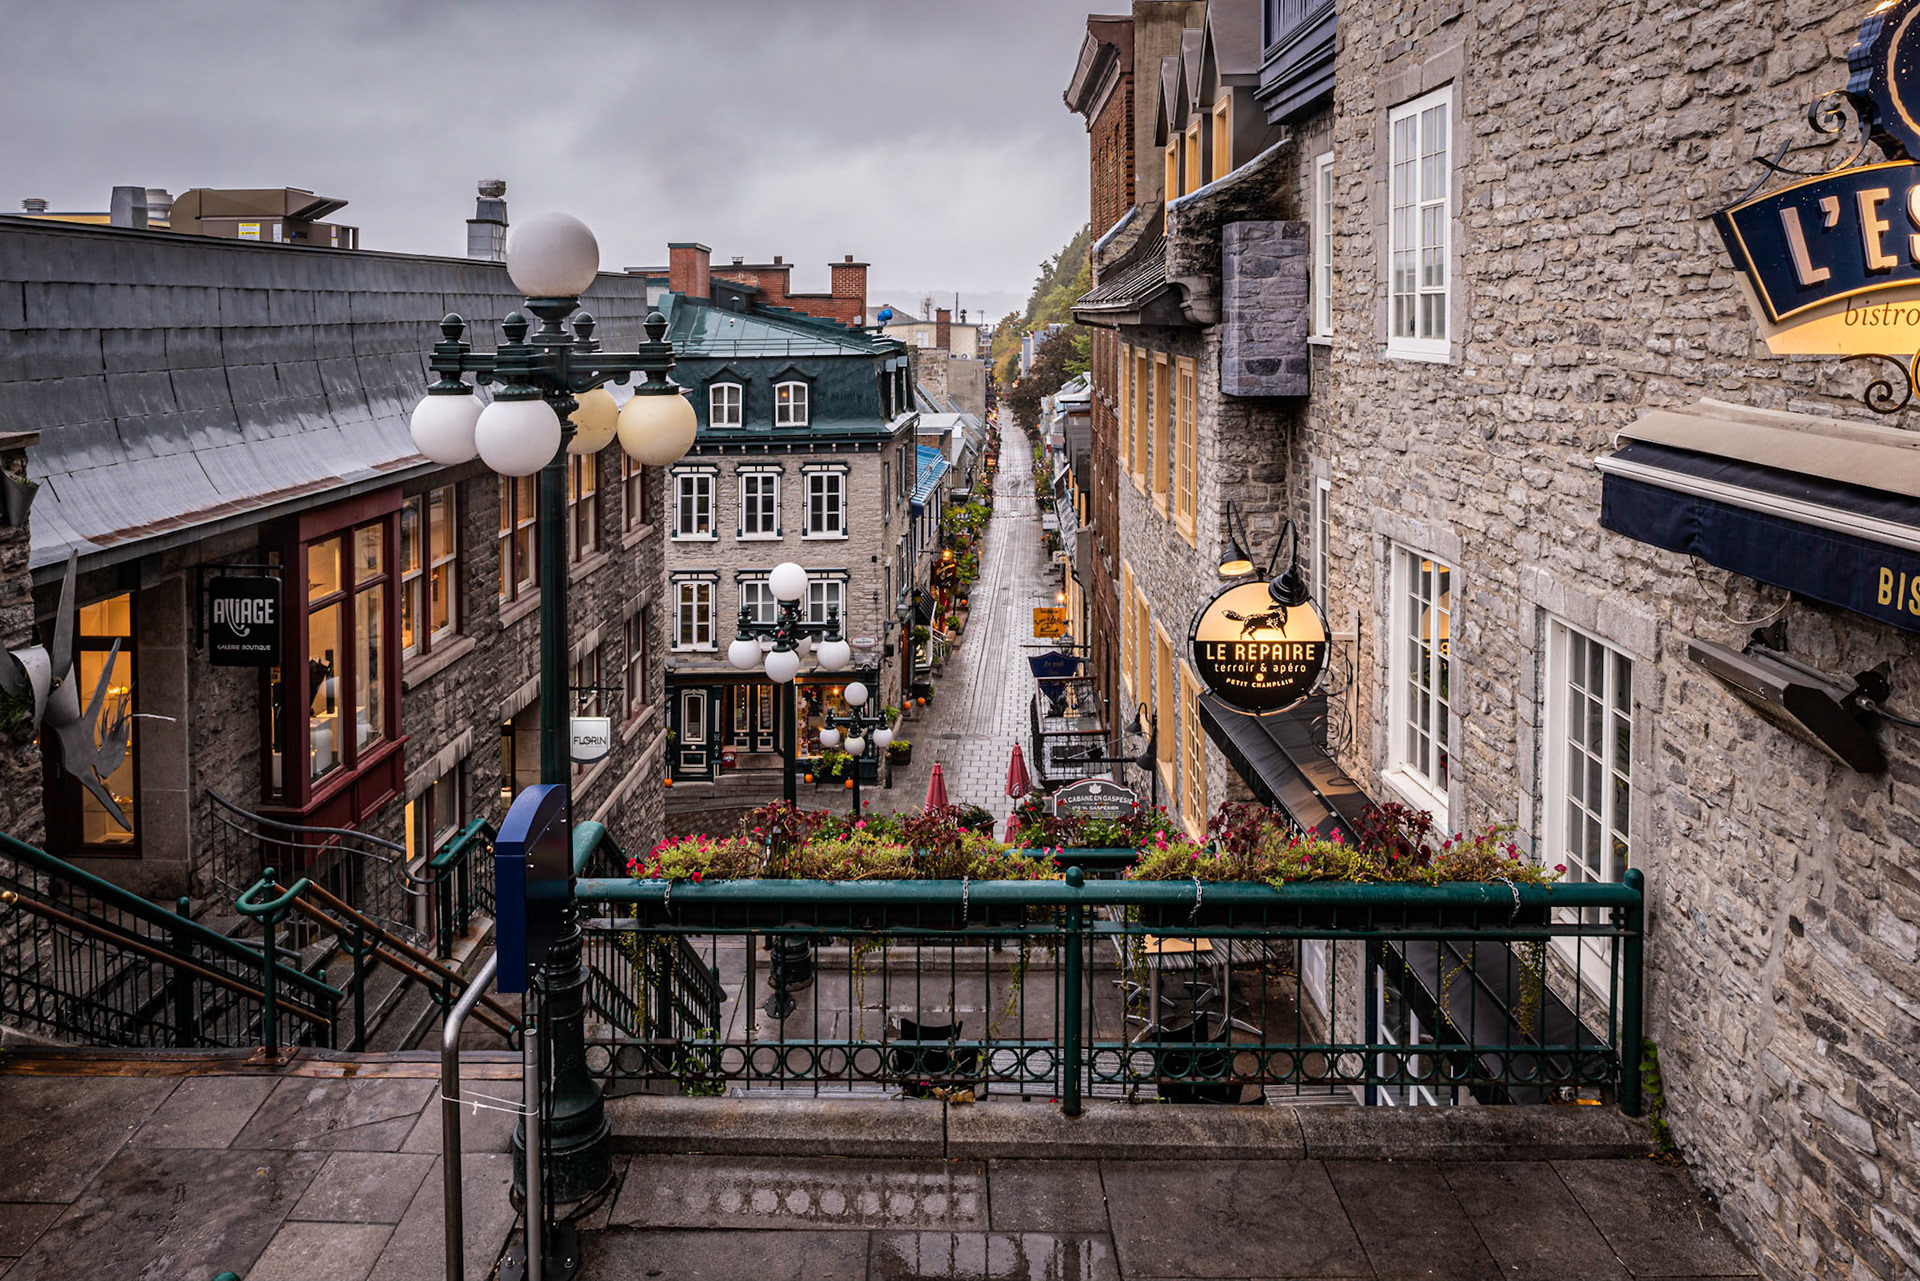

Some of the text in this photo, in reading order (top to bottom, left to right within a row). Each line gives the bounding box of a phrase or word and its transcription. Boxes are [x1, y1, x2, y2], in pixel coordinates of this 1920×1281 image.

[1844, 298, 1920, 326] bistro
[241, 644, 271, 652] BOUTIQUE
[1206, 643, 1315, 660] LE REPAIRE
[1214, 662, 1307, 675] terroir & apéro
[1226, 677, 1294, 688] PETIT CHAMPLAIN
[573, 736, 607, 745] FLORIN
[1067, 795, 1093, 803] CABANE
